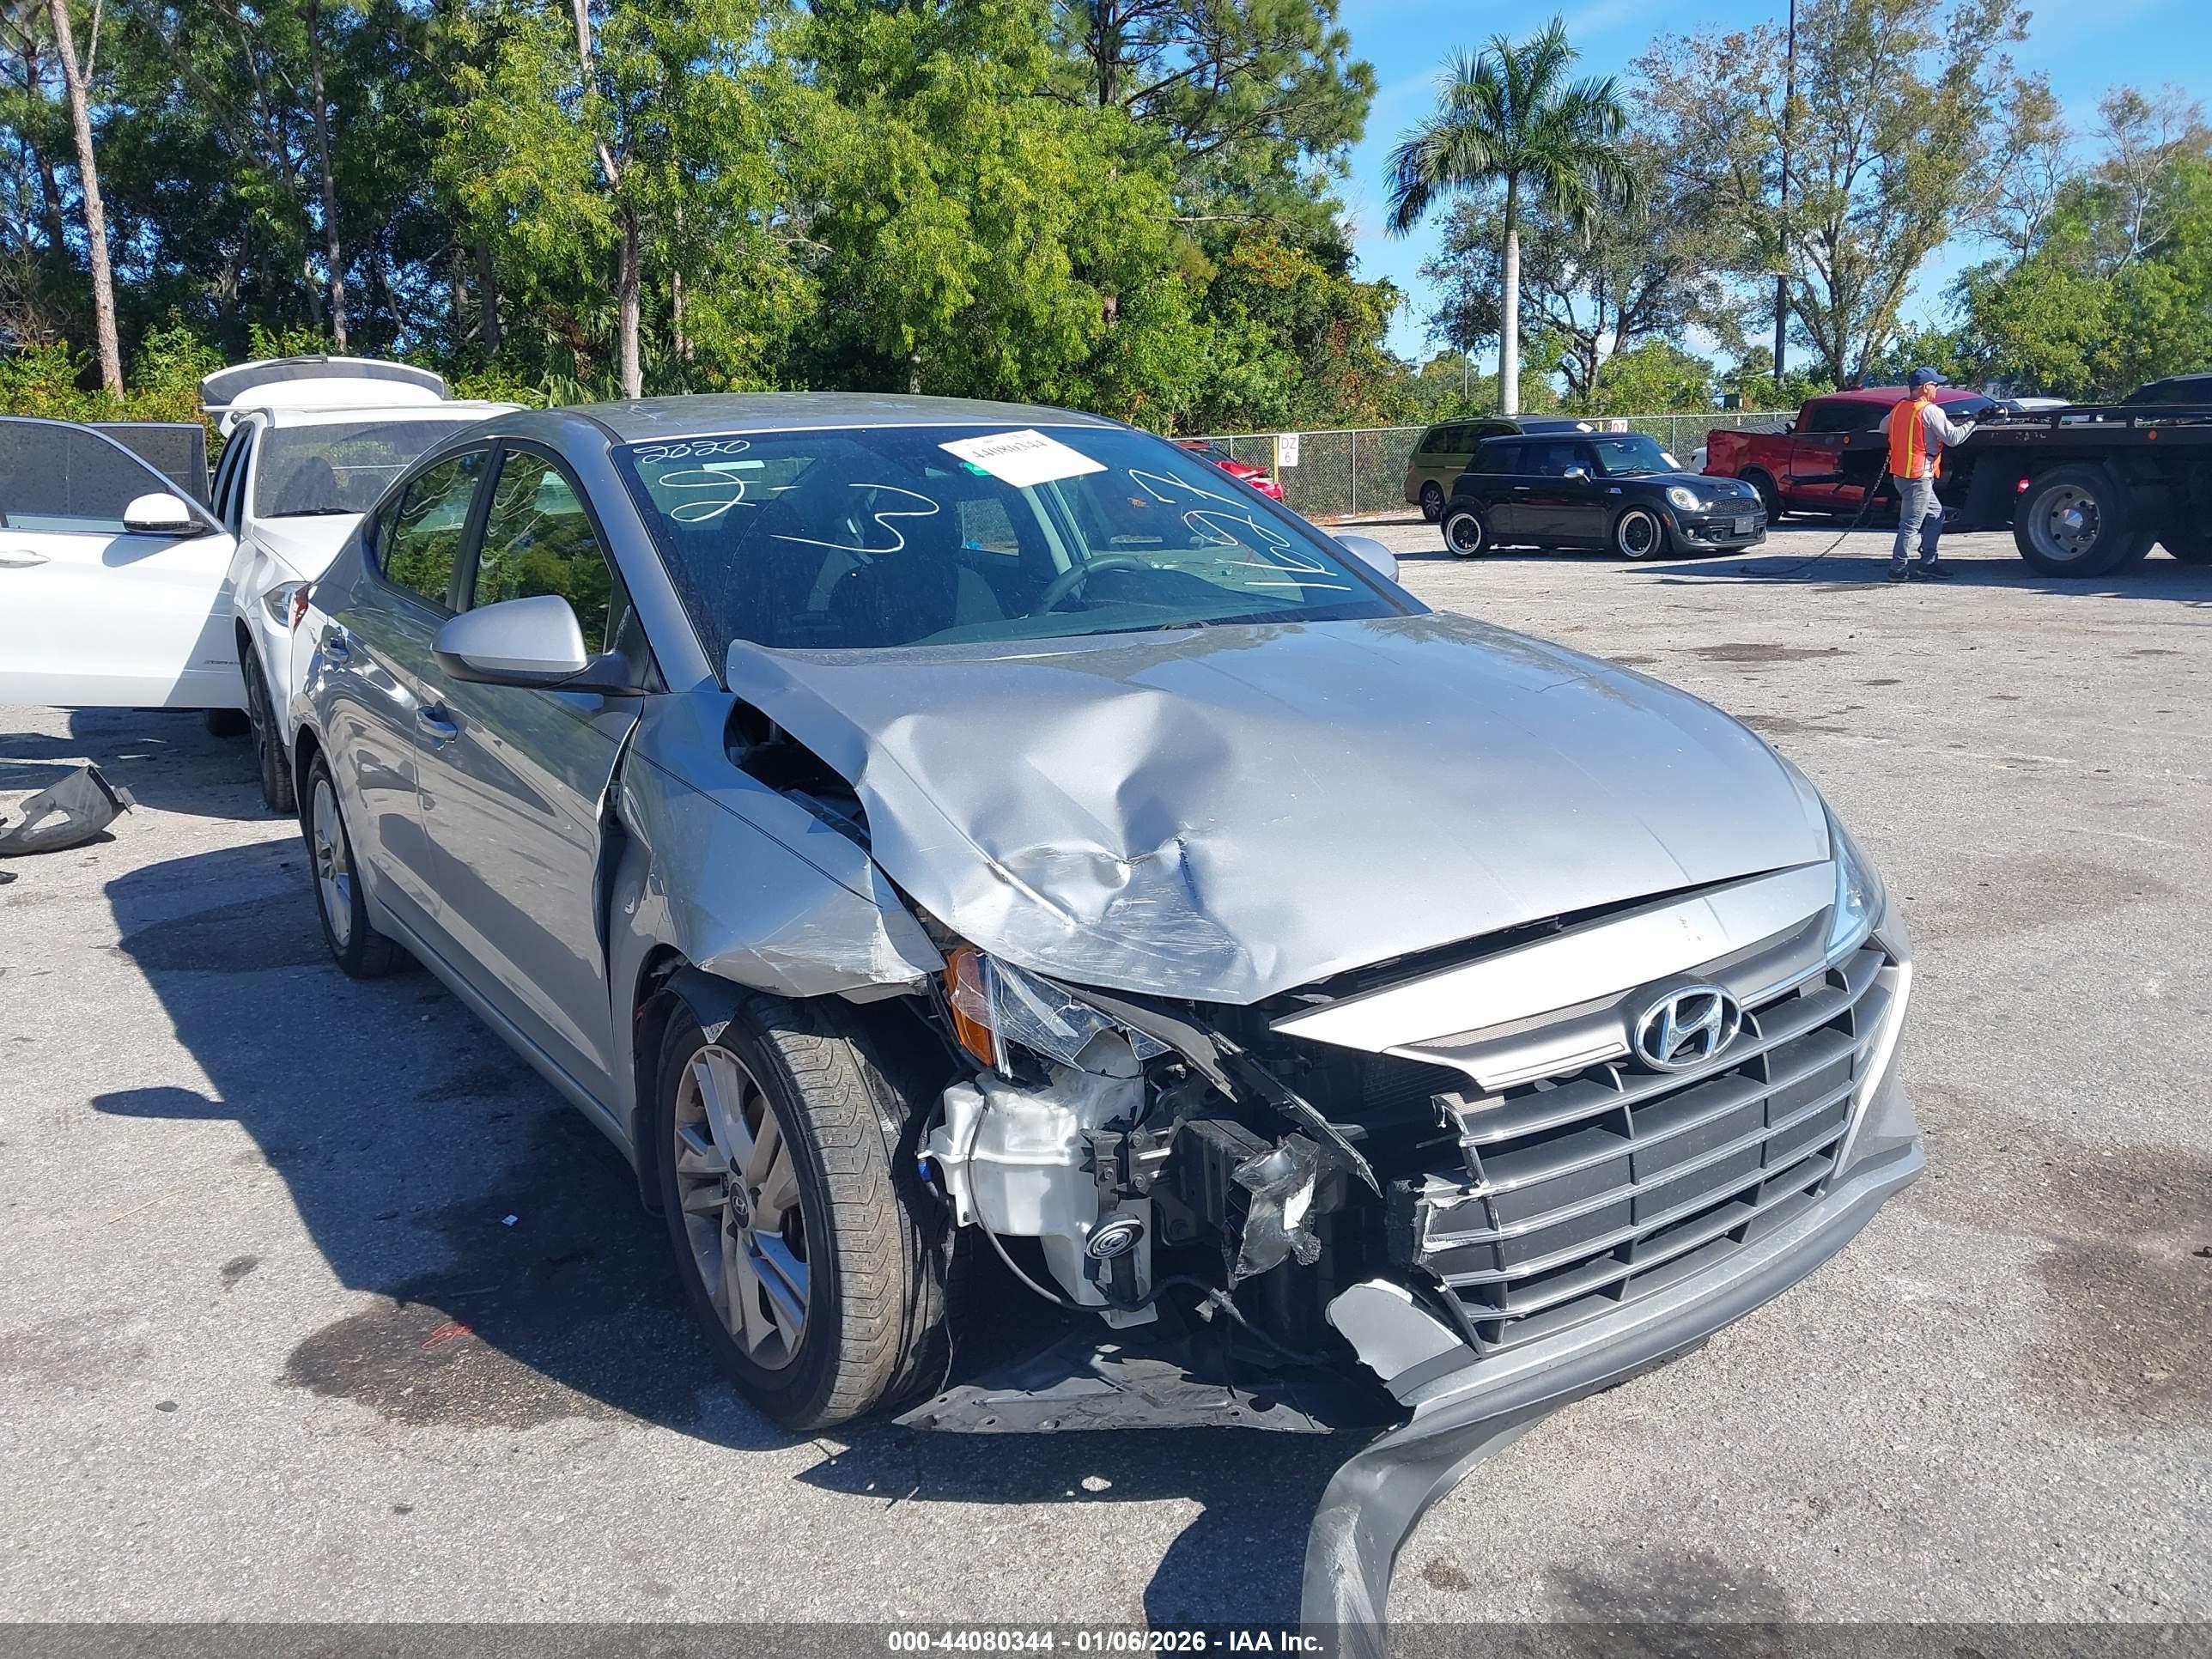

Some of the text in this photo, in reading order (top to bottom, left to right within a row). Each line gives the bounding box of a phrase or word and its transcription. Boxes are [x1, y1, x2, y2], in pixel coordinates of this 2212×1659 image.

[972, 440, 1049, 459] 44080344
[1281, 437, 1297, 449] DZ
[633, 440, 750, 464] 2020
[1285, 451, 1291, 463] 6
